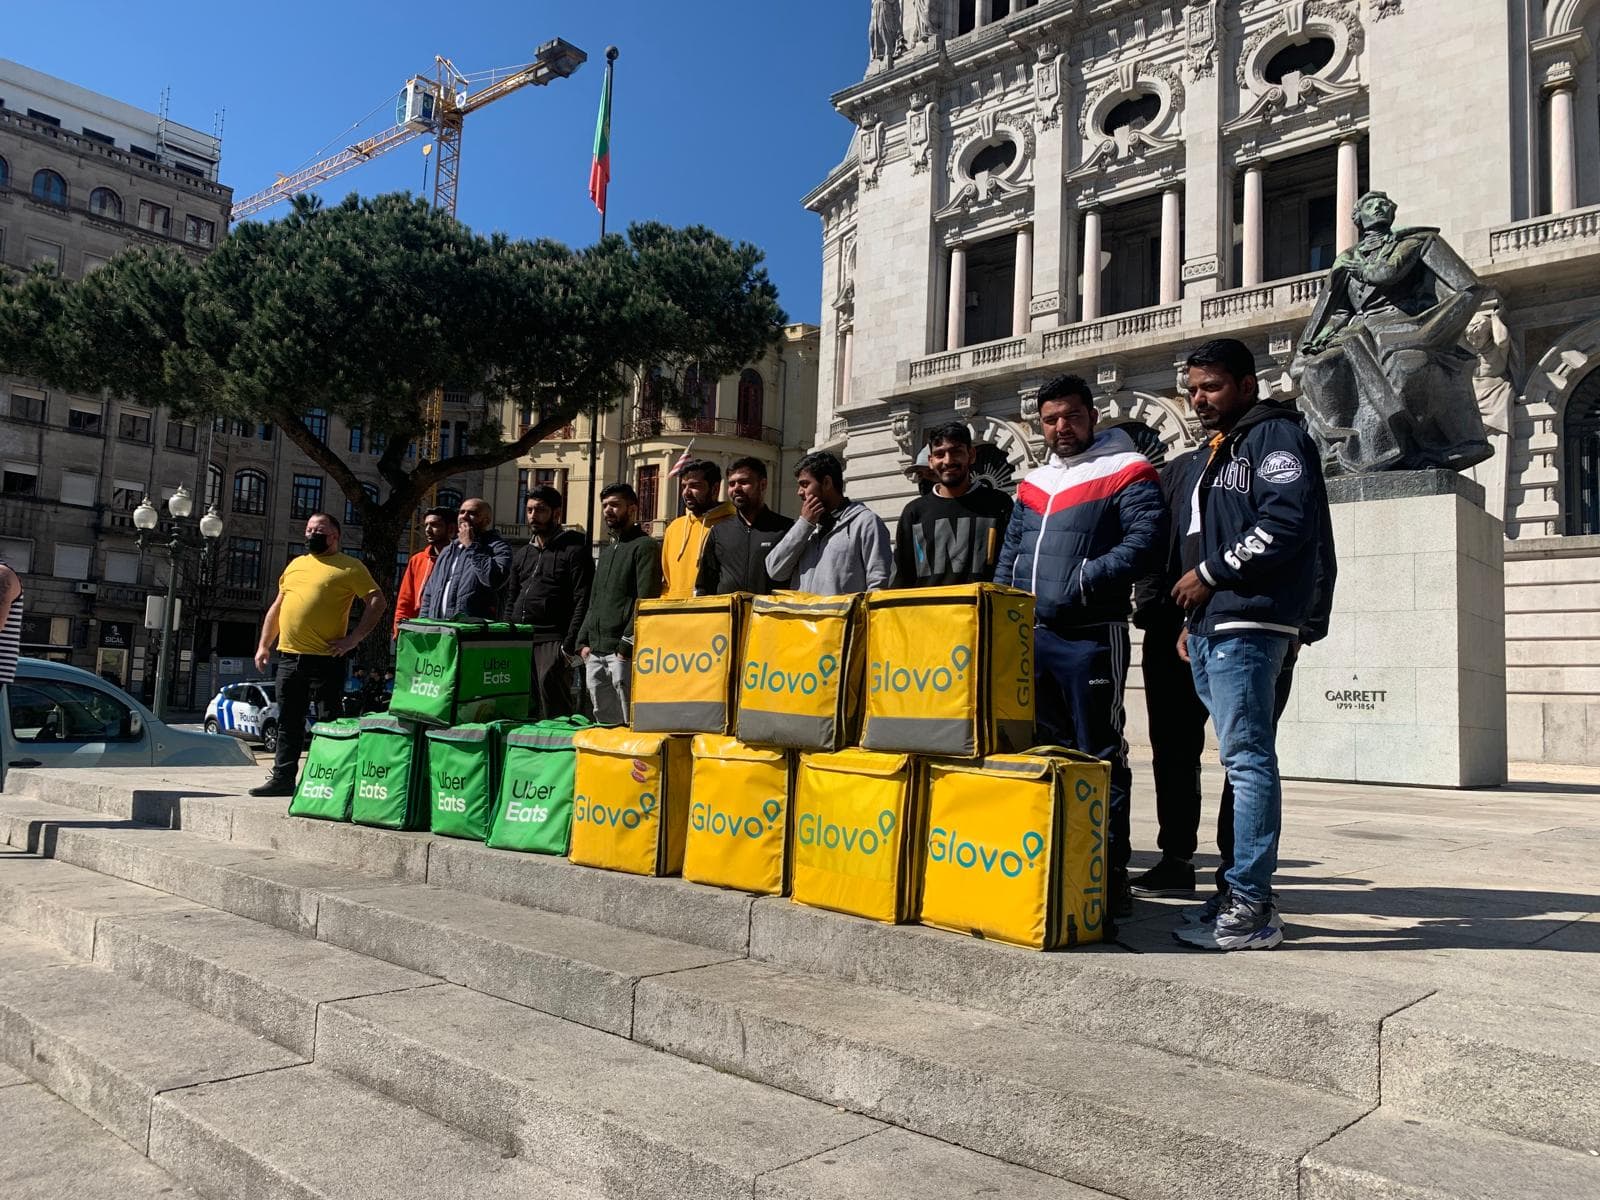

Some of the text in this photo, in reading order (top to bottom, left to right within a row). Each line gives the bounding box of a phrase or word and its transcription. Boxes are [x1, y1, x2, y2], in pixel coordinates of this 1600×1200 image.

[415, 657, 446, 678] Uber
[483, 656, 511, 670] Uber
[636, 647, 712, 675] Glovo
[1016, 621, 1031, 708] Glovo
[410, 677, 440, 698] Eats
[483, 672, 511, 684] Eats
[744, 661, 818, 695] Glovo
[871, 661, 952, 693] Glovo
[1325, 690, 1387, 702] GARRETT
[308, 762, 338, 781] Uber
[362, 760, 391, 779] Uber
[301, 781, 334, 800] Eats
[358, 779, 388, 800] Eats
[437, 771, 467, 790] Uber
[512, 779, 556, 800] Uber
[438, 791, 466, 813] Eats
[505, 802, 548, 823] Eats
[575, 795, 641, 830] Glovo
[691, 803, 764, 839] Glovo
[799, 813, 878, 855] Glovo
[928, 828, 1023, 878] Glovo
[1083, 799, 1104, 932] Glovo
